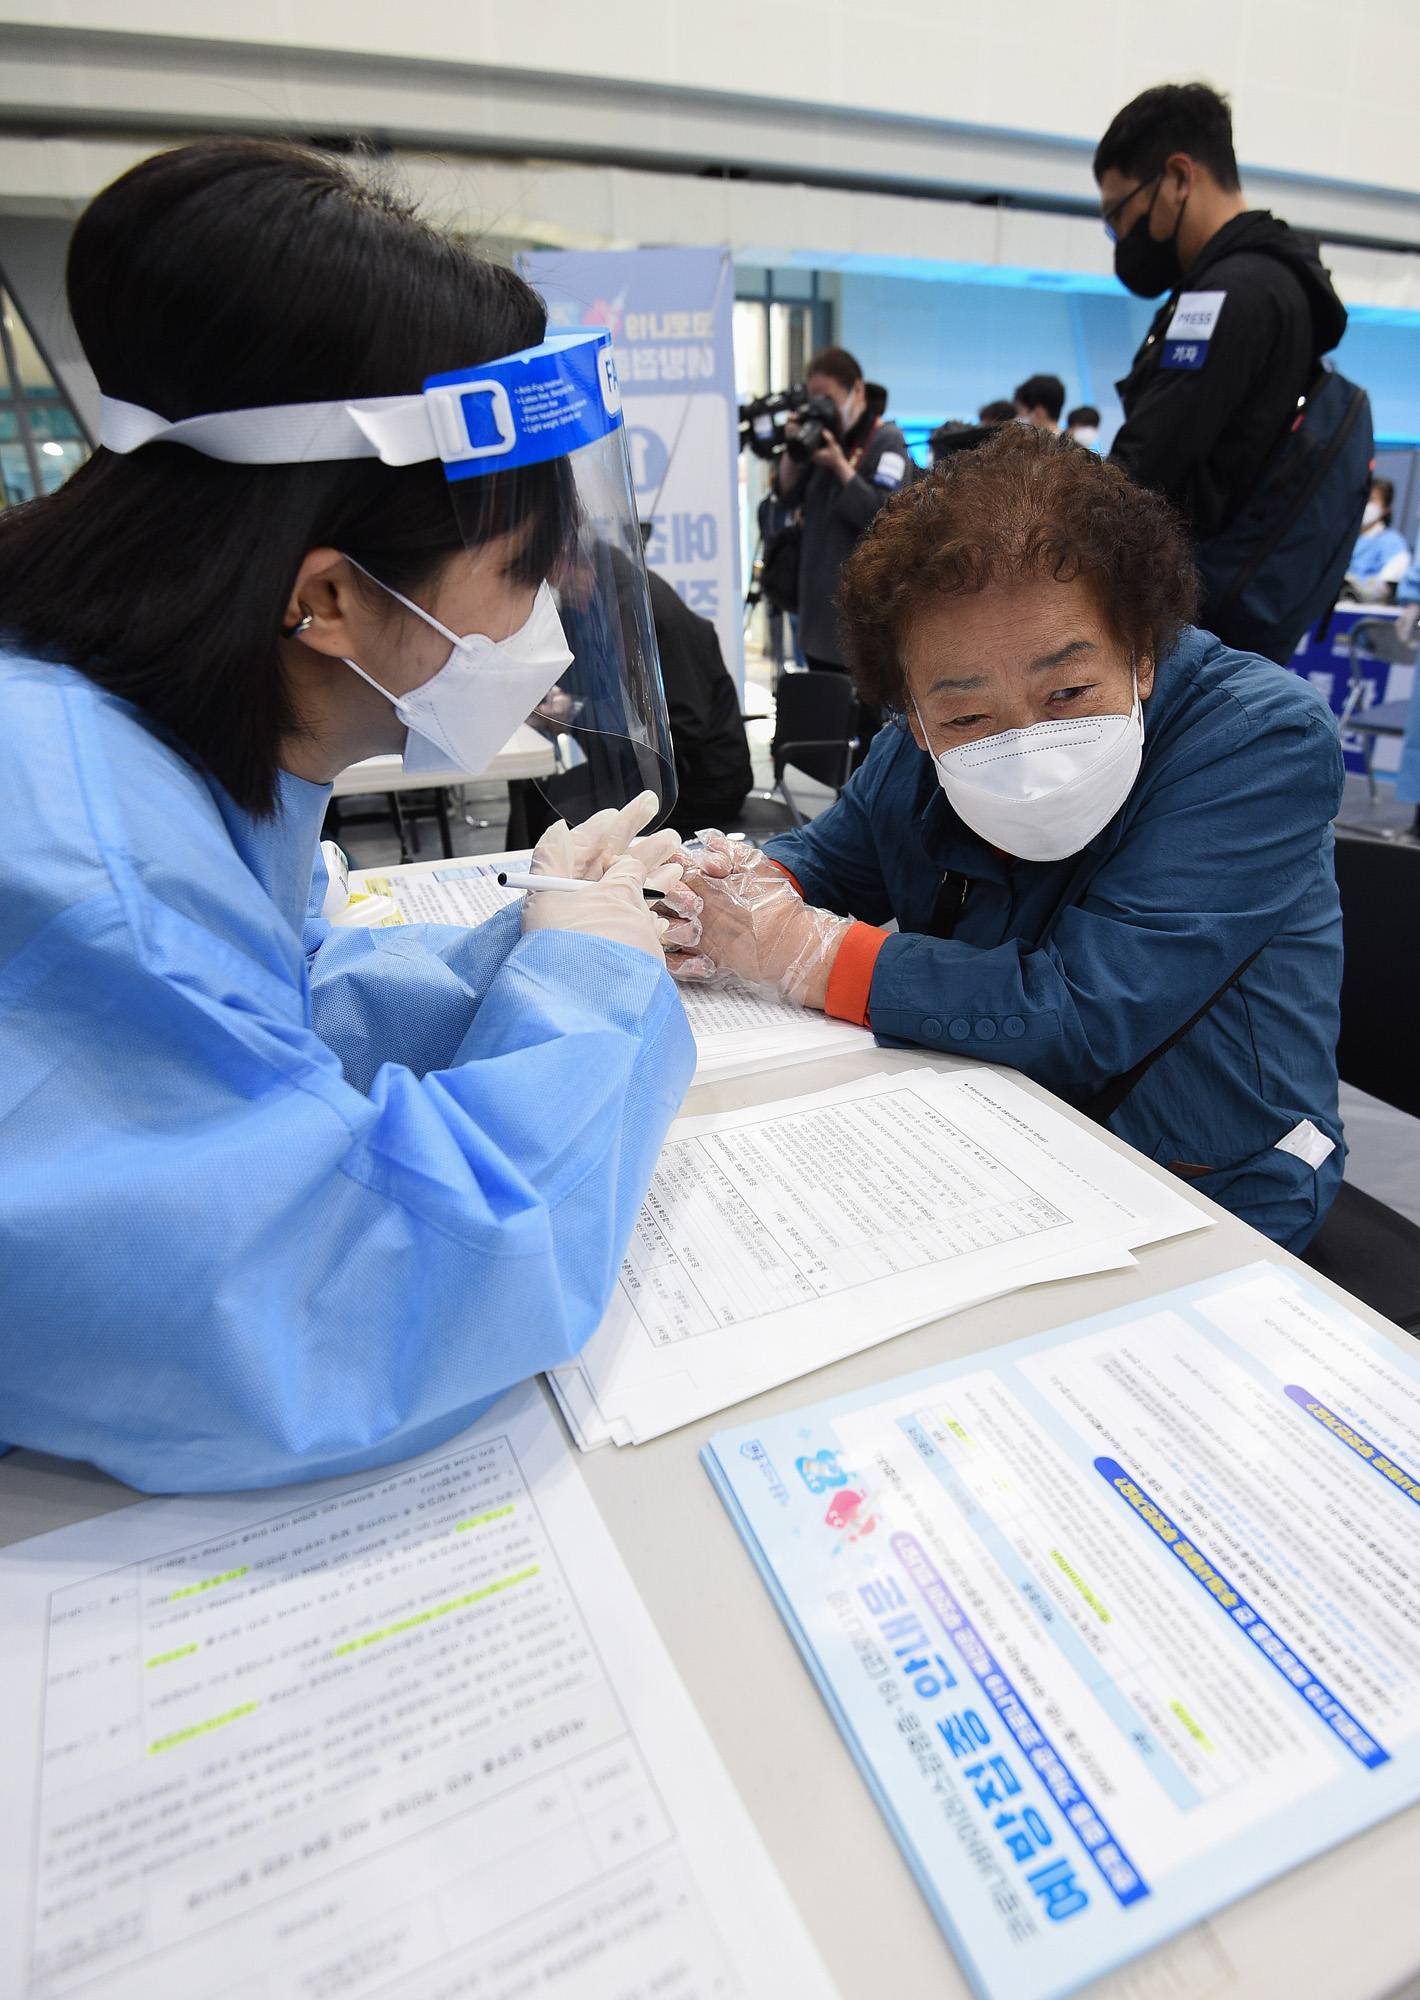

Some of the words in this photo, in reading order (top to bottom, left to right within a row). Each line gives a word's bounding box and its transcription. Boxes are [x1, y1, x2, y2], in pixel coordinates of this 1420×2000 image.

[1177, 312, 1213, 326] PRESS
[1302, 1399, 1378, 1458] 무엇인가요?
[1110, 1473, 1182, 1543] 무엇인가요?
[923, 1582, 967, 1630] 무엇이
[1169, 1538, 1242, 1609] 주의사항은
[855, 1572, 959, 1702] 안내문
[950, 1625, 998, 1677] 백신은
[1245, 1621, 1314, 1688] 예방접종
[980, 1670, 1046, 1751] 코로나19
[1299, 1680, 1378, 1759] 코로나19
[934, 1704, 1093, 1926] 예방접종
